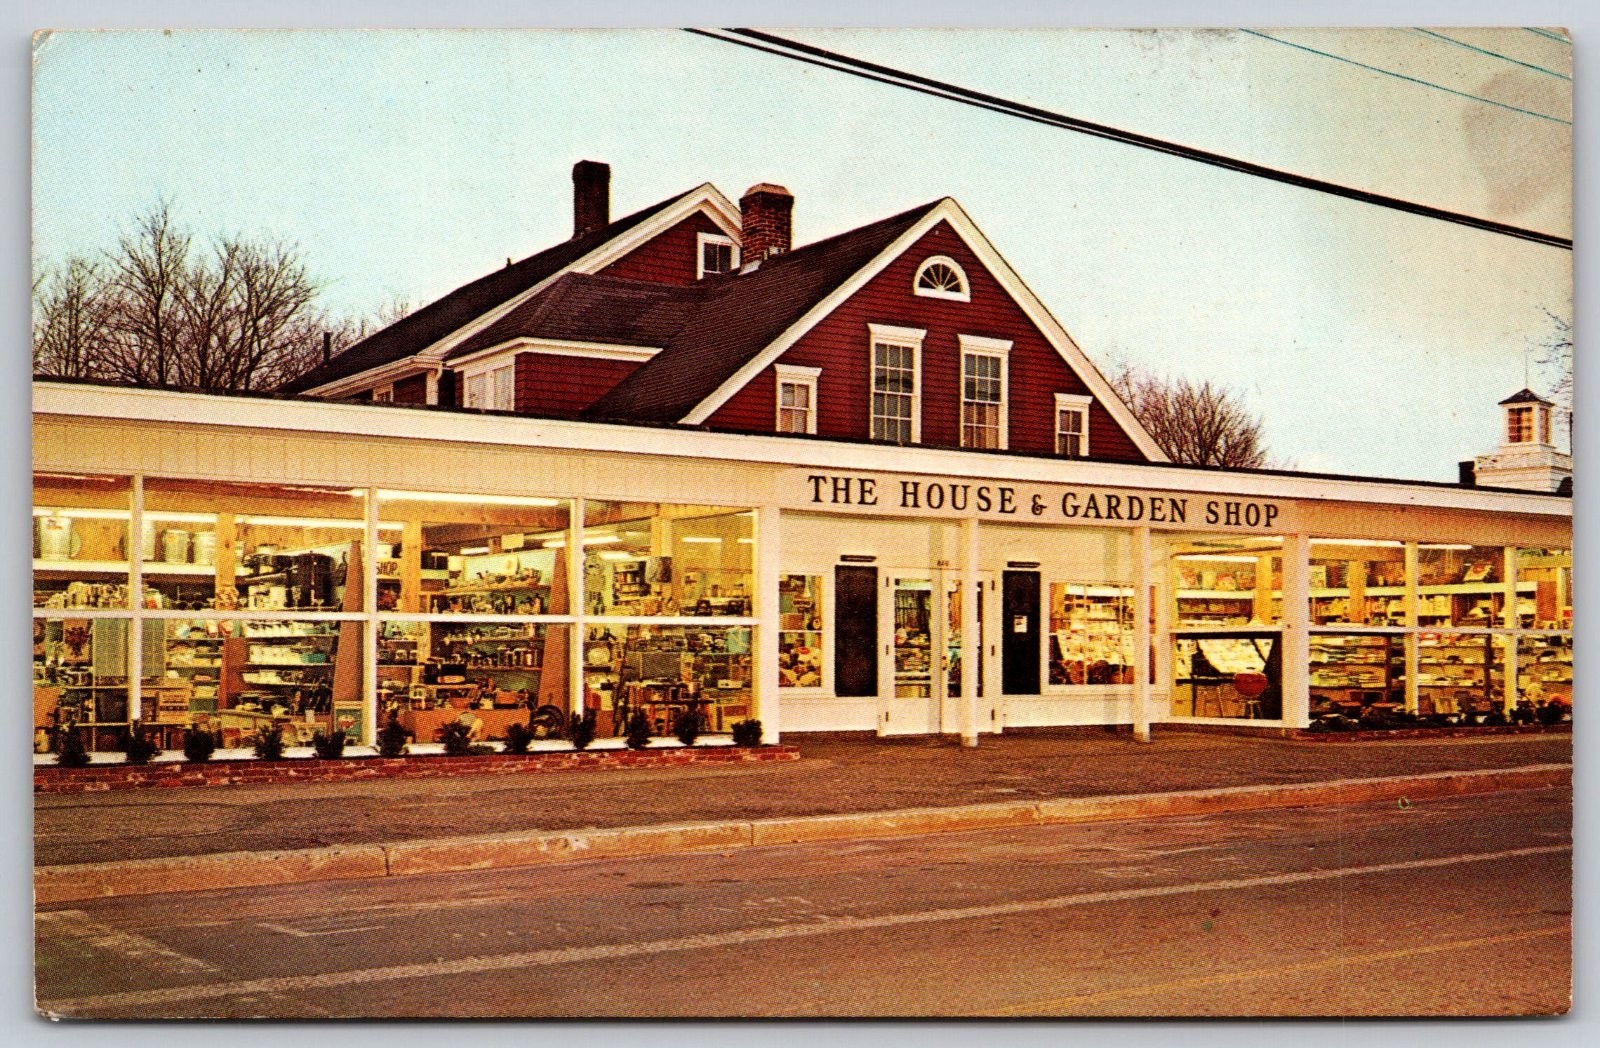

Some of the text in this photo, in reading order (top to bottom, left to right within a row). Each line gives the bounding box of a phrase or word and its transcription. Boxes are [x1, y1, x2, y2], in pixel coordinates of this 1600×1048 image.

[808, 475, 1279, 527] THE HOUSE & GARDEN SHOP
